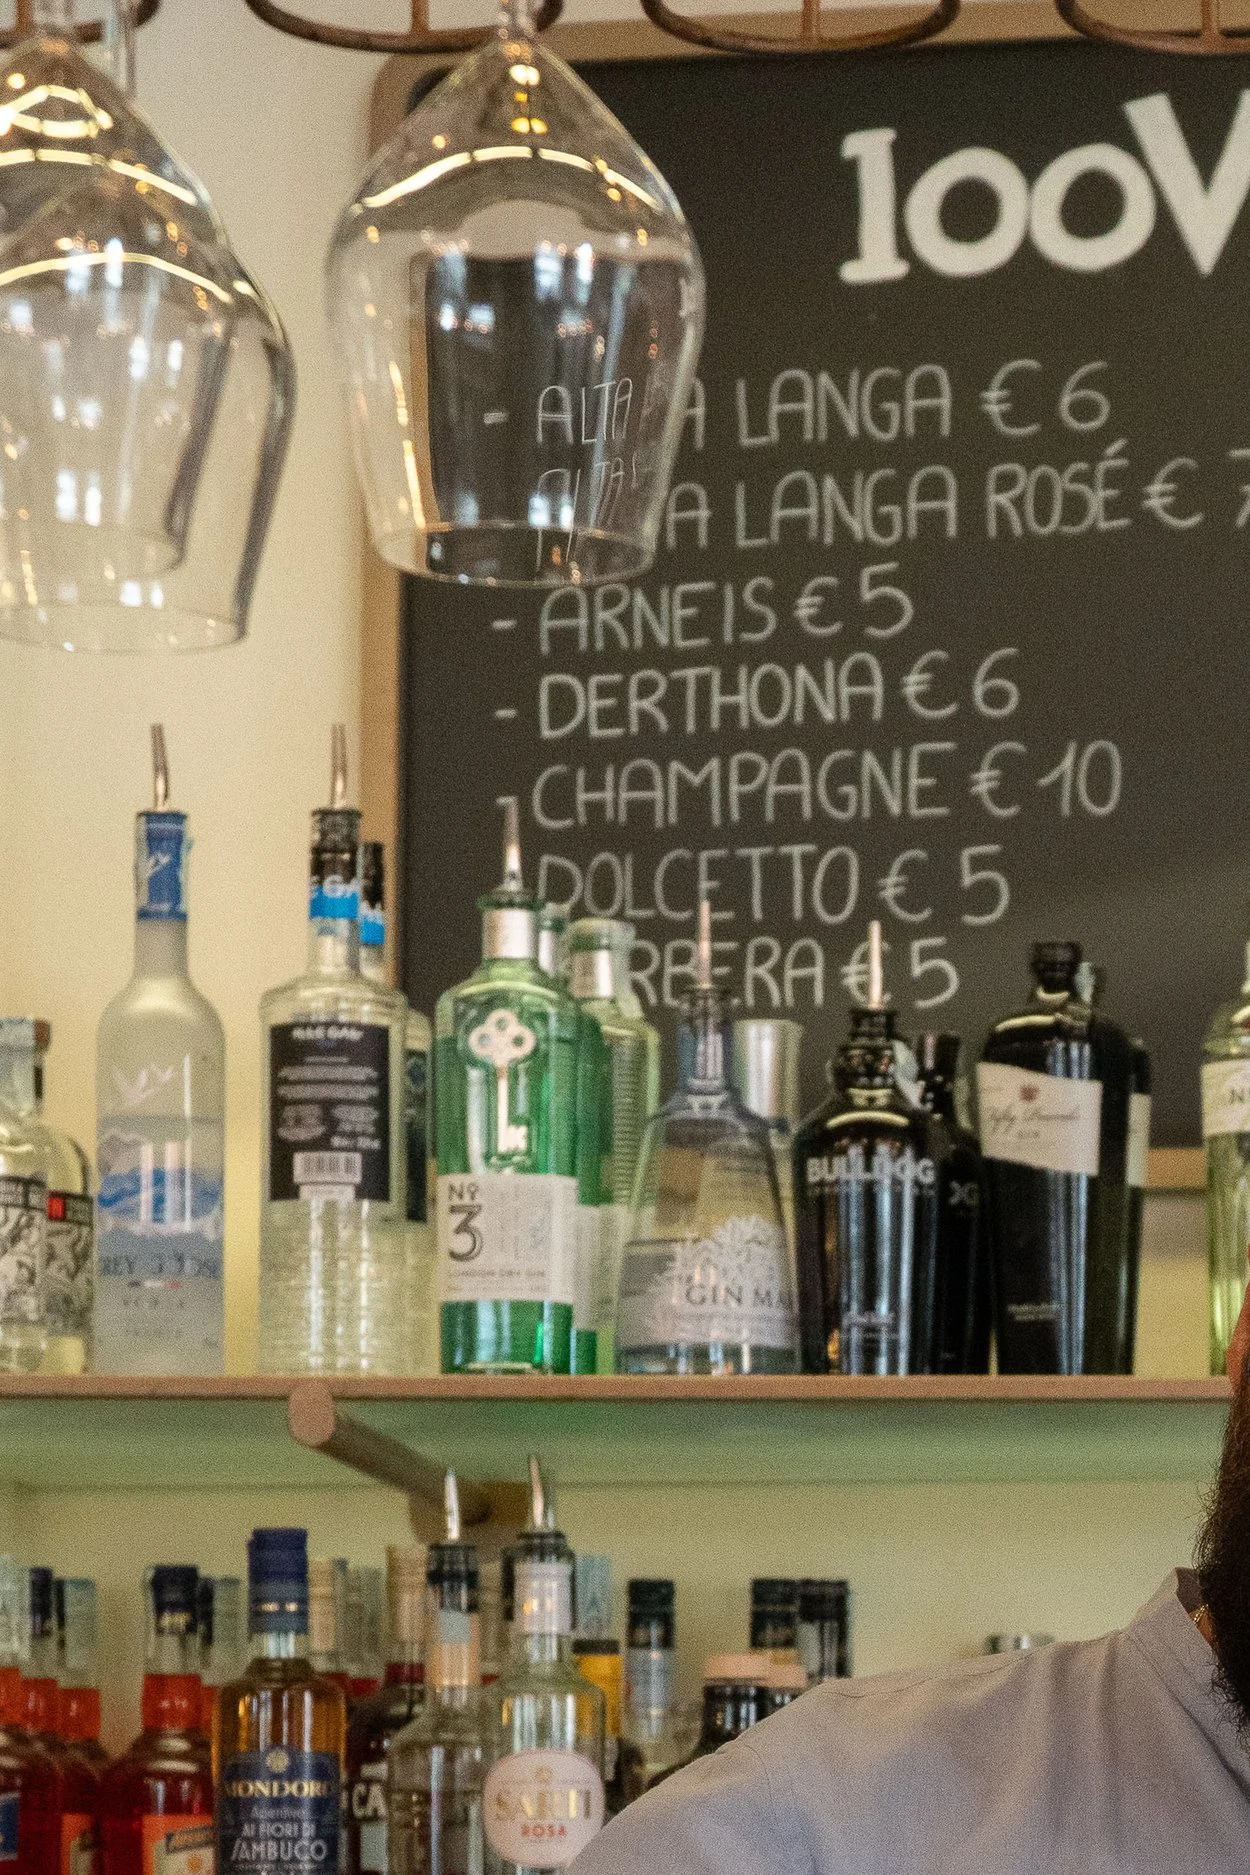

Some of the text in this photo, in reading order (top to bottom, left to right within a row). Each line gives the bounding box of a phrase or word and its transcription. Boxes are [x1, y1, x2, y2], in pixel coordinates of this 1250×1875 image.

[736, 364, 952, 448] LANGA
[735, 465, 958, 549] LANGA
[986, 439, 1131, 538] ROSÉ
[538, 577, 777, 655] ARNEIS
[538, 653, 884, 739] DERTHONA
[532, 743, 957, 830] CHAMPAGNE
[540, 843, 859, 925] DOLCETTO
[628, 936, 824, 1008] RBERA
[806, 1156, 936, 1184] BULLDOG
[449, 1204, 483, 1262] 3
[685, 1283, 744, 1306] GIN
[520, 1824, 567, 1838] ROSA
